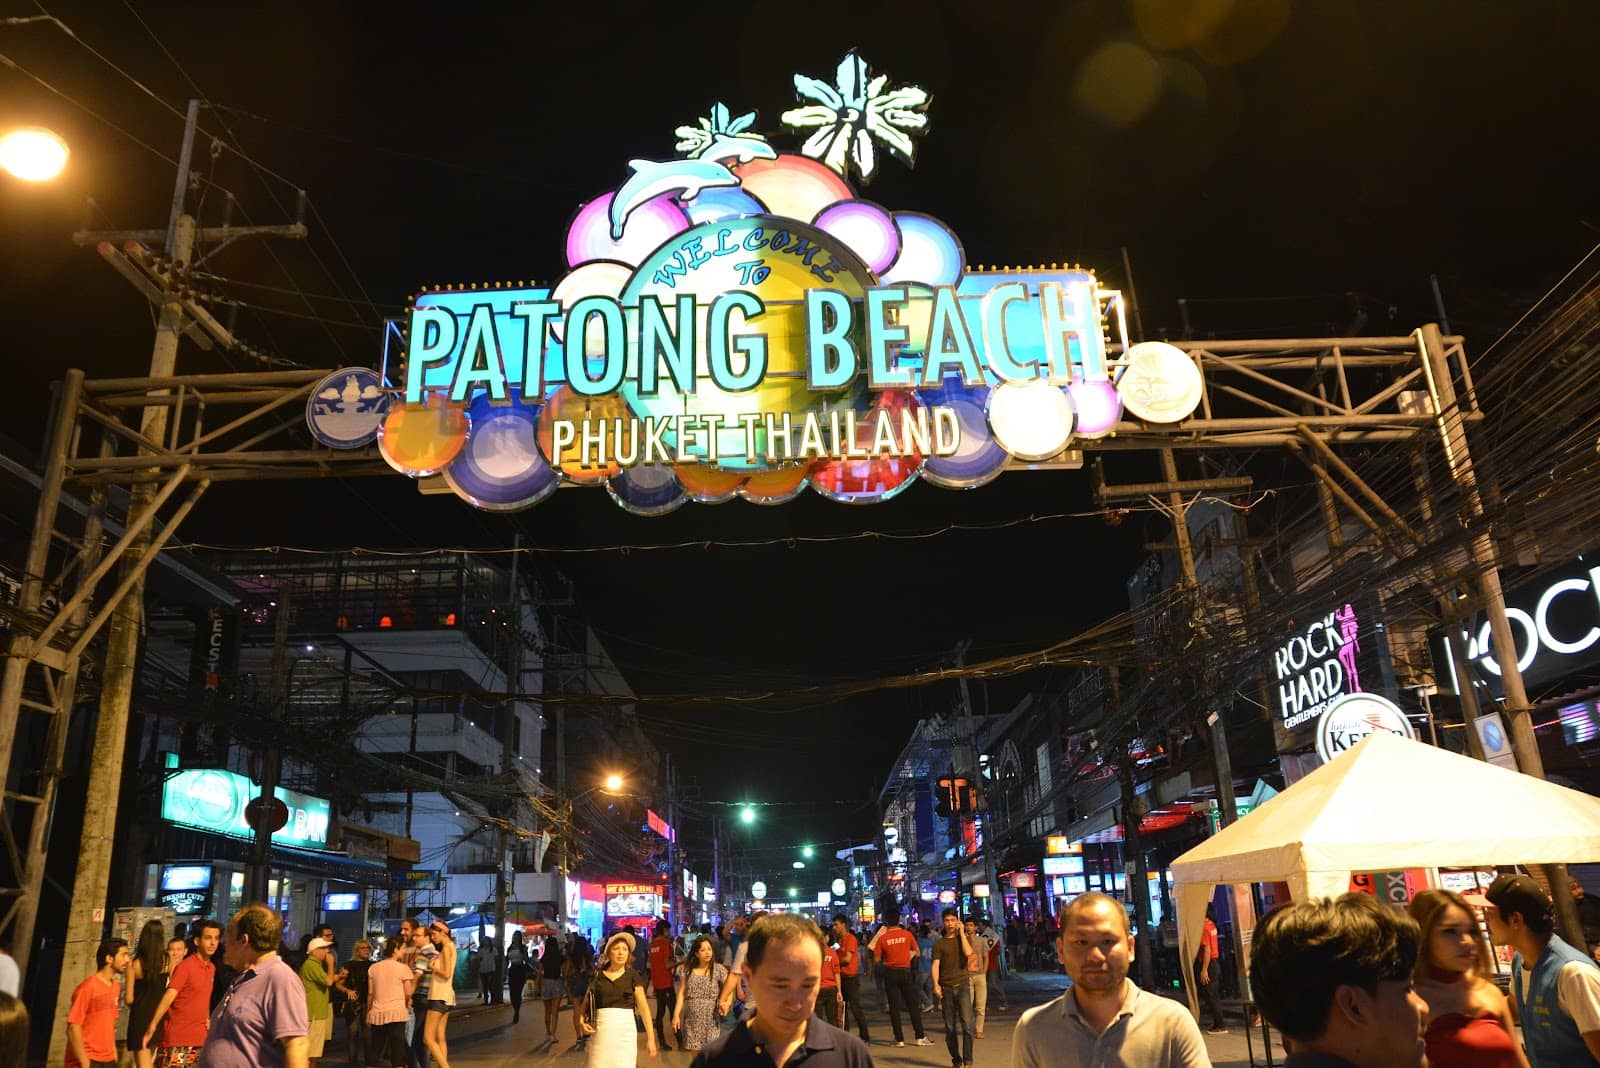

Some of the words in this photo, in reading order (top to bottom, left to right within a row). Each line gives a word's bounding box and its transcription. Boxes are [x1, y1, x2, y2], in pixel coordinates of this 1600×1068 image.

[653, 227, 848, 289] WELCOME
[735, 260, 768, 286] TO
[403, 289, 769, 405] PATONG
[804, 281, 1110, 391] BEACH
[551, 413, 724, 468] PHUKET
[743, 404, 963, 460] THAILAND
[1274, 612, 1345, 680] ROCK
[1279, 658, 1343, 719] HARD
[886, 937, 906, 946] STAFF
